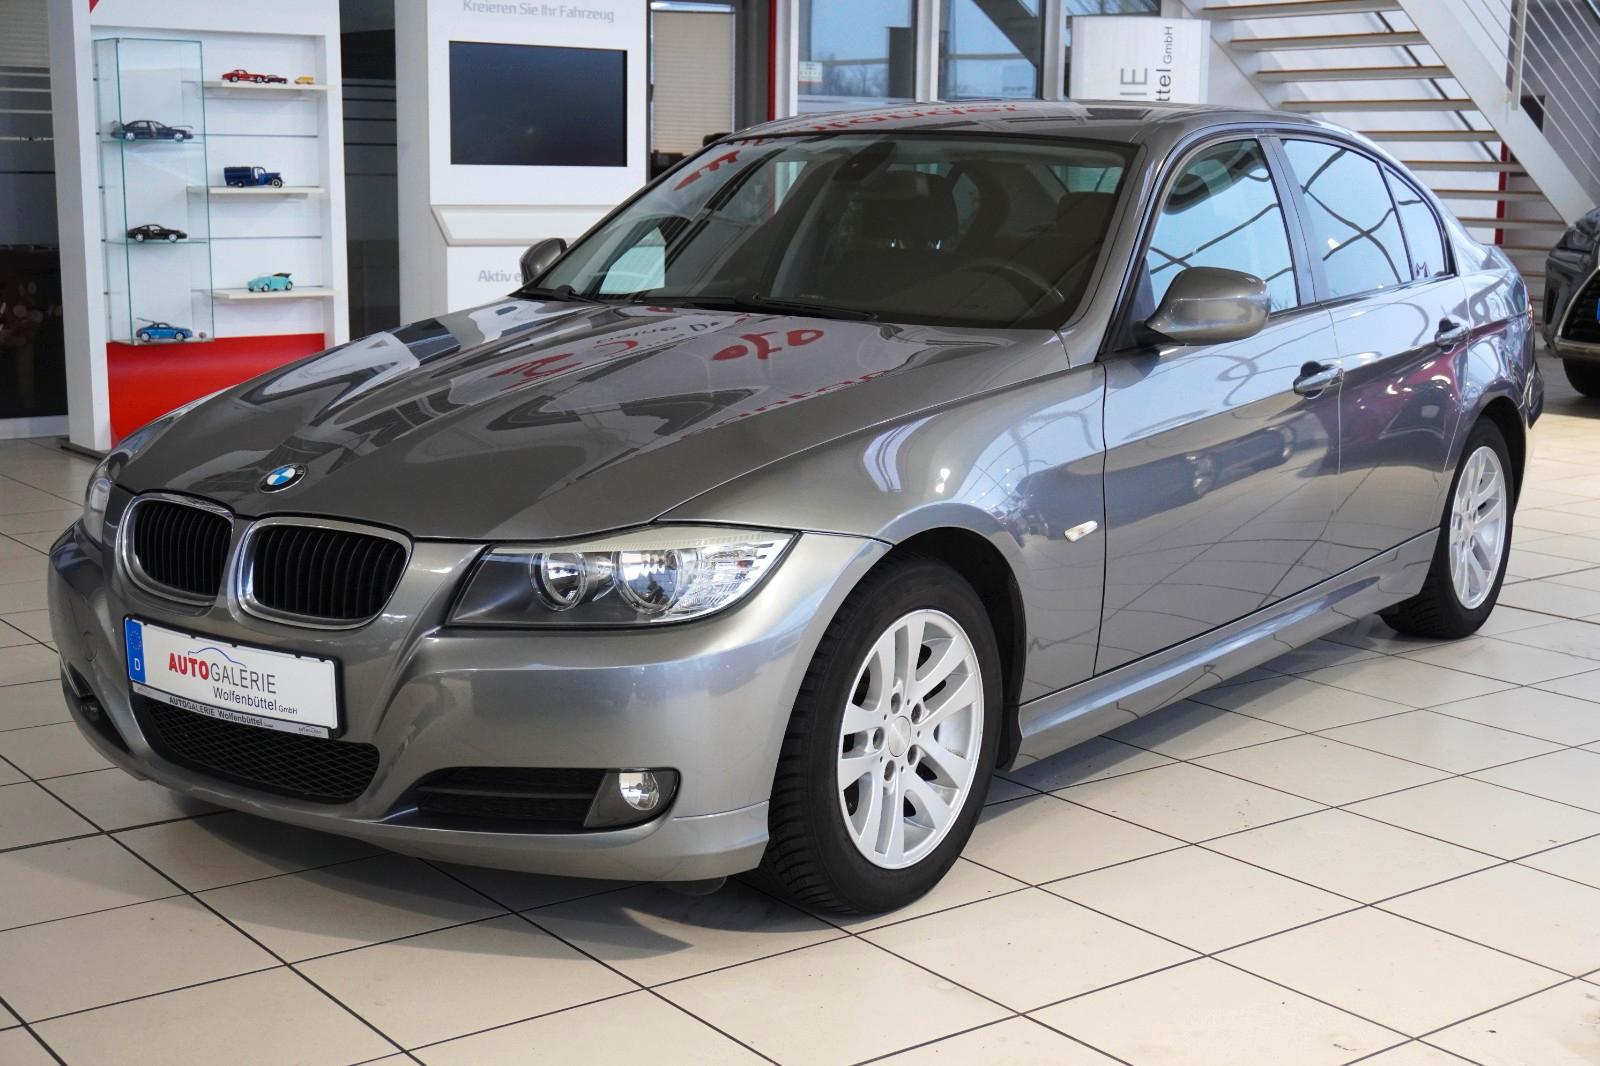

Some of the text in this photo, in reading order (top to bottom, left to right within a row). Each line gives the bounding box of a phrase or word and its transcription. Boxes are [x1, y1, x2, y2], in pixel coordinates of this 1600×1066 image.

[463, 0, 615, 23] Kreieren Sie Ihr Fahrzeug
[1163, 26, 1173, 65] GmbH
[477, 269, 512, 282] Aktiv
[134, 658, 141, 671] D
[168, 652, 277, 694] AUTOGALERIE
[169, 696, 263, 727] AUTOGALERIE Wolfenbüttel
[213, 686, 298, 715] Wolfenbüttel GmbH
